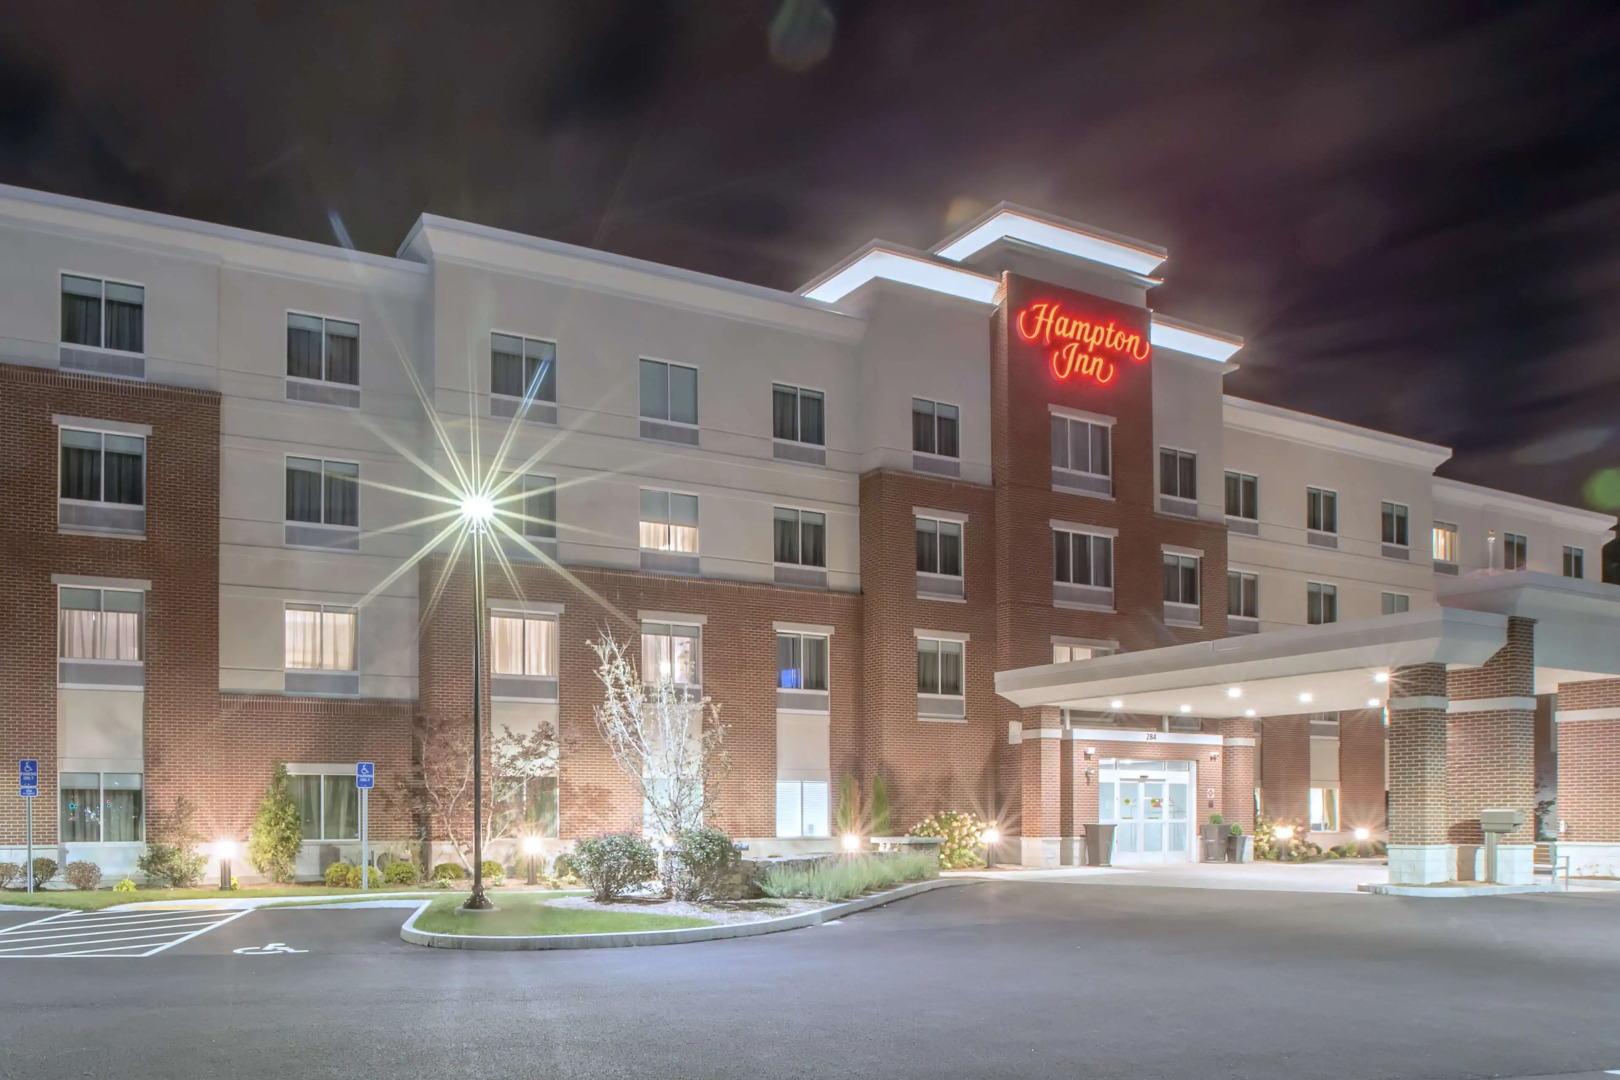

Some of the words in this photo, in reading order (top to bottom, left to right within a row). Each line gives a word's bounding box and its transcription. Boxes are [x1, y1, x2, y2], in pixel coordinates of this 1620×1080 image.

[1019, 303, 1150, 360] Hampton
[1053, 342, 1114, 383] Inn
[1146, 732, 1157, 741] 284
